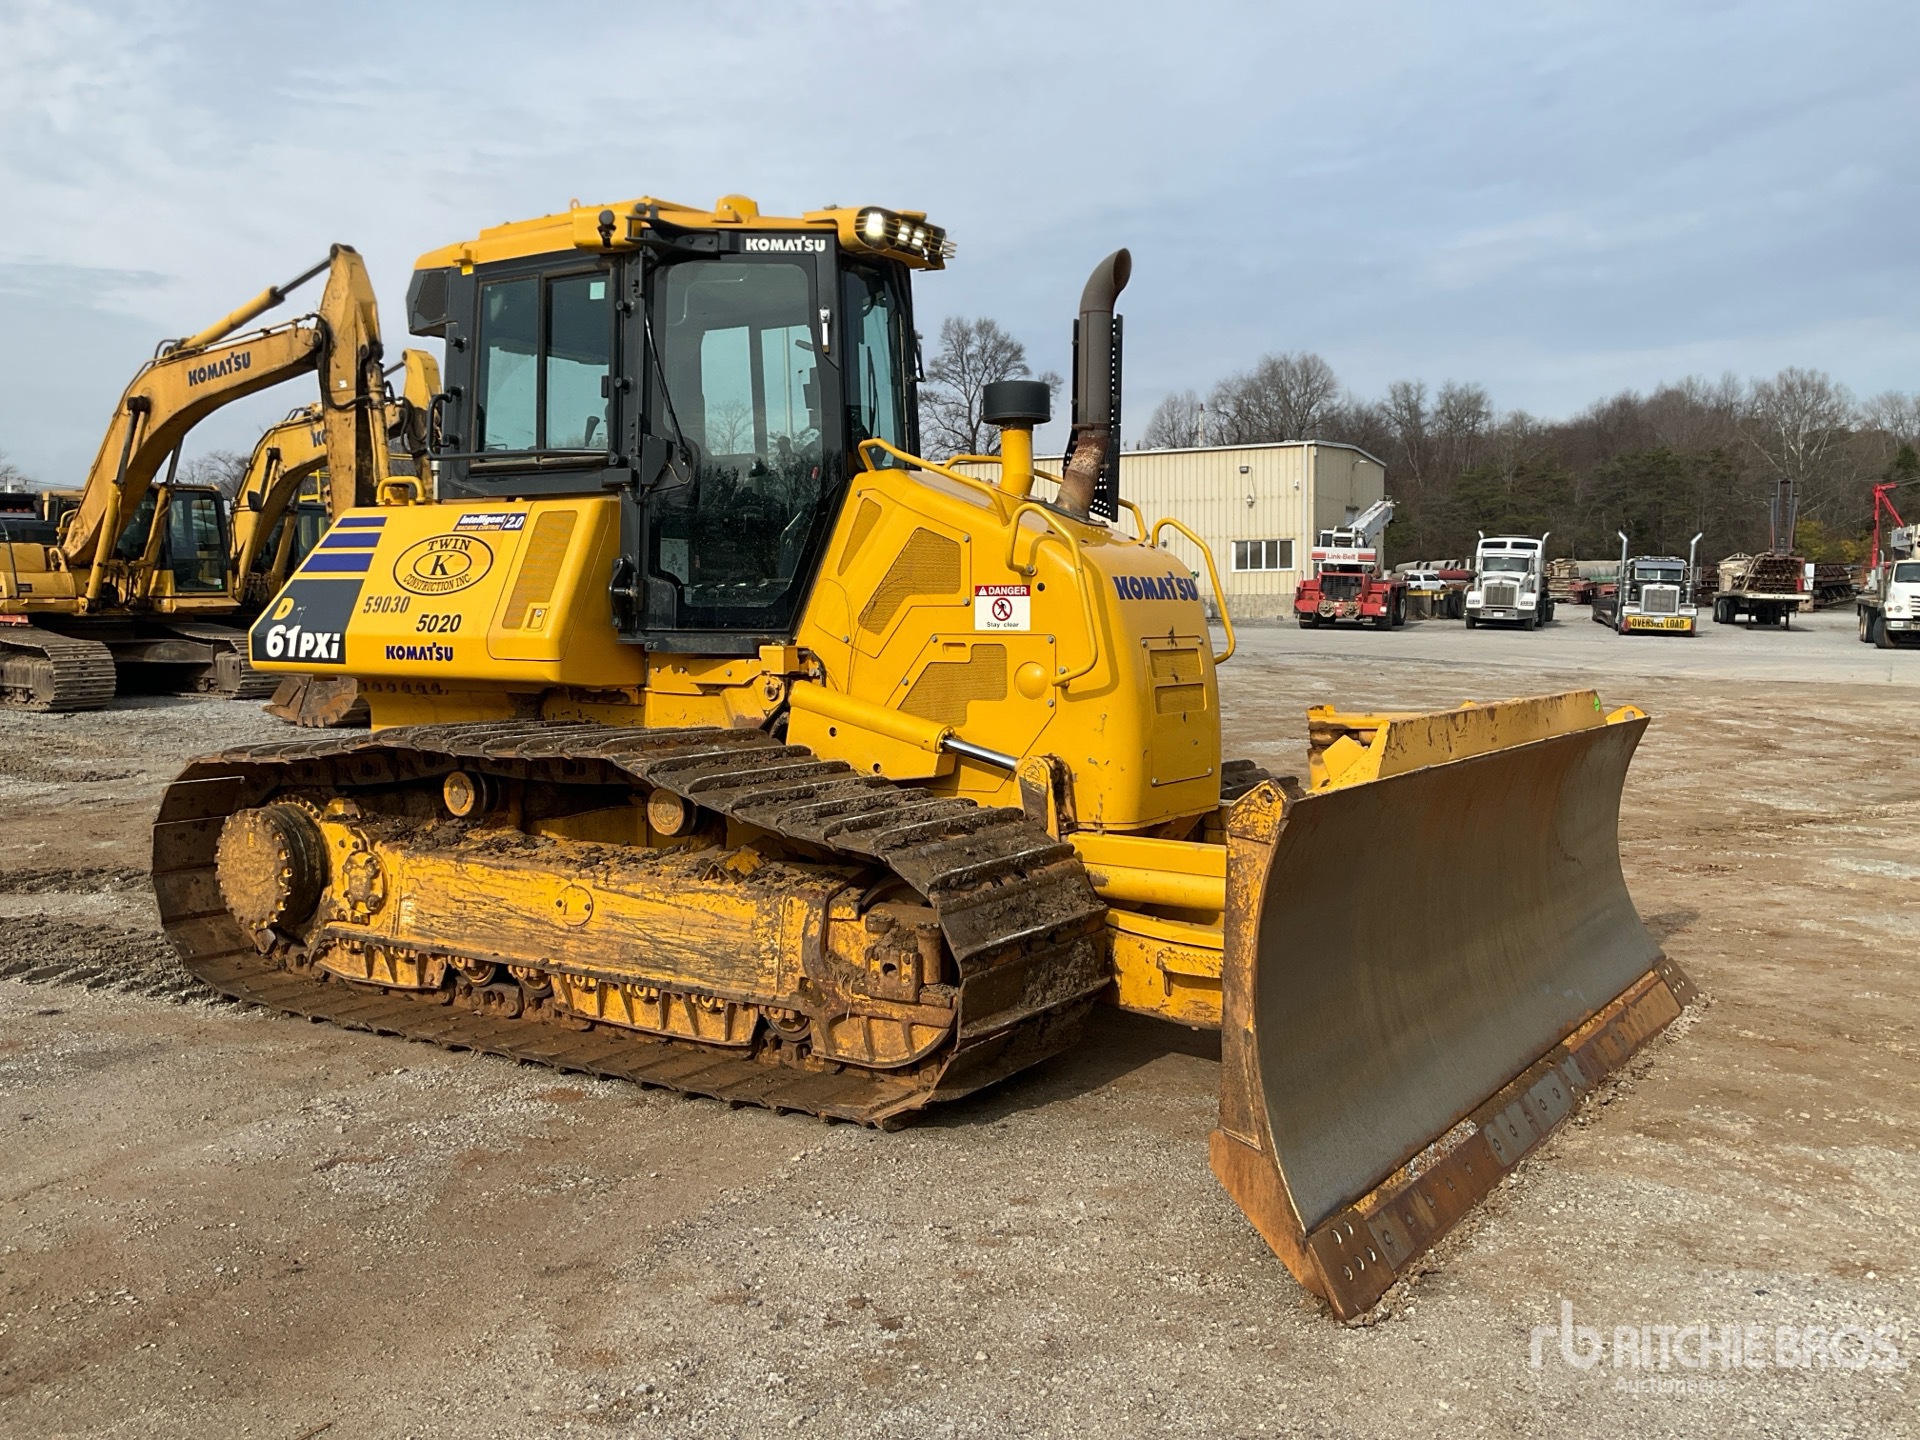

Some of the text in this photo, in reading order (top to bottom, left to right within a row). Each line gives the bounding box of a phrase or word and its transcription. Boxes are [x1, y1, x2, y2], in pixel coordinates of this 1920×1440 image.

[746, 236, 826, 251] KOMATSU
[188, 351, 251, 386] KOMATSU
[460, 516, 524, 528] intelligent 2.0
[427, 538, 472, 551] TWIN
[429, 554, 455, 575] K
[403, 573, 456, 592] CONSTRUCTION
[988, 586, 1028, 596] DANGER
[1112, 572, 1198, 601] KOMATSU
[272, 598, 294, 620] D
[363, 595, 411, 614] 59030
[415, 613, 462, 633] 5020
[986, 621, 1001, 629] Stay
[1666, 619, 1685, 629] LOAD
[266, 625, 340, 658] 61PXi
[385, 642, 454, 662] KOMATSU
